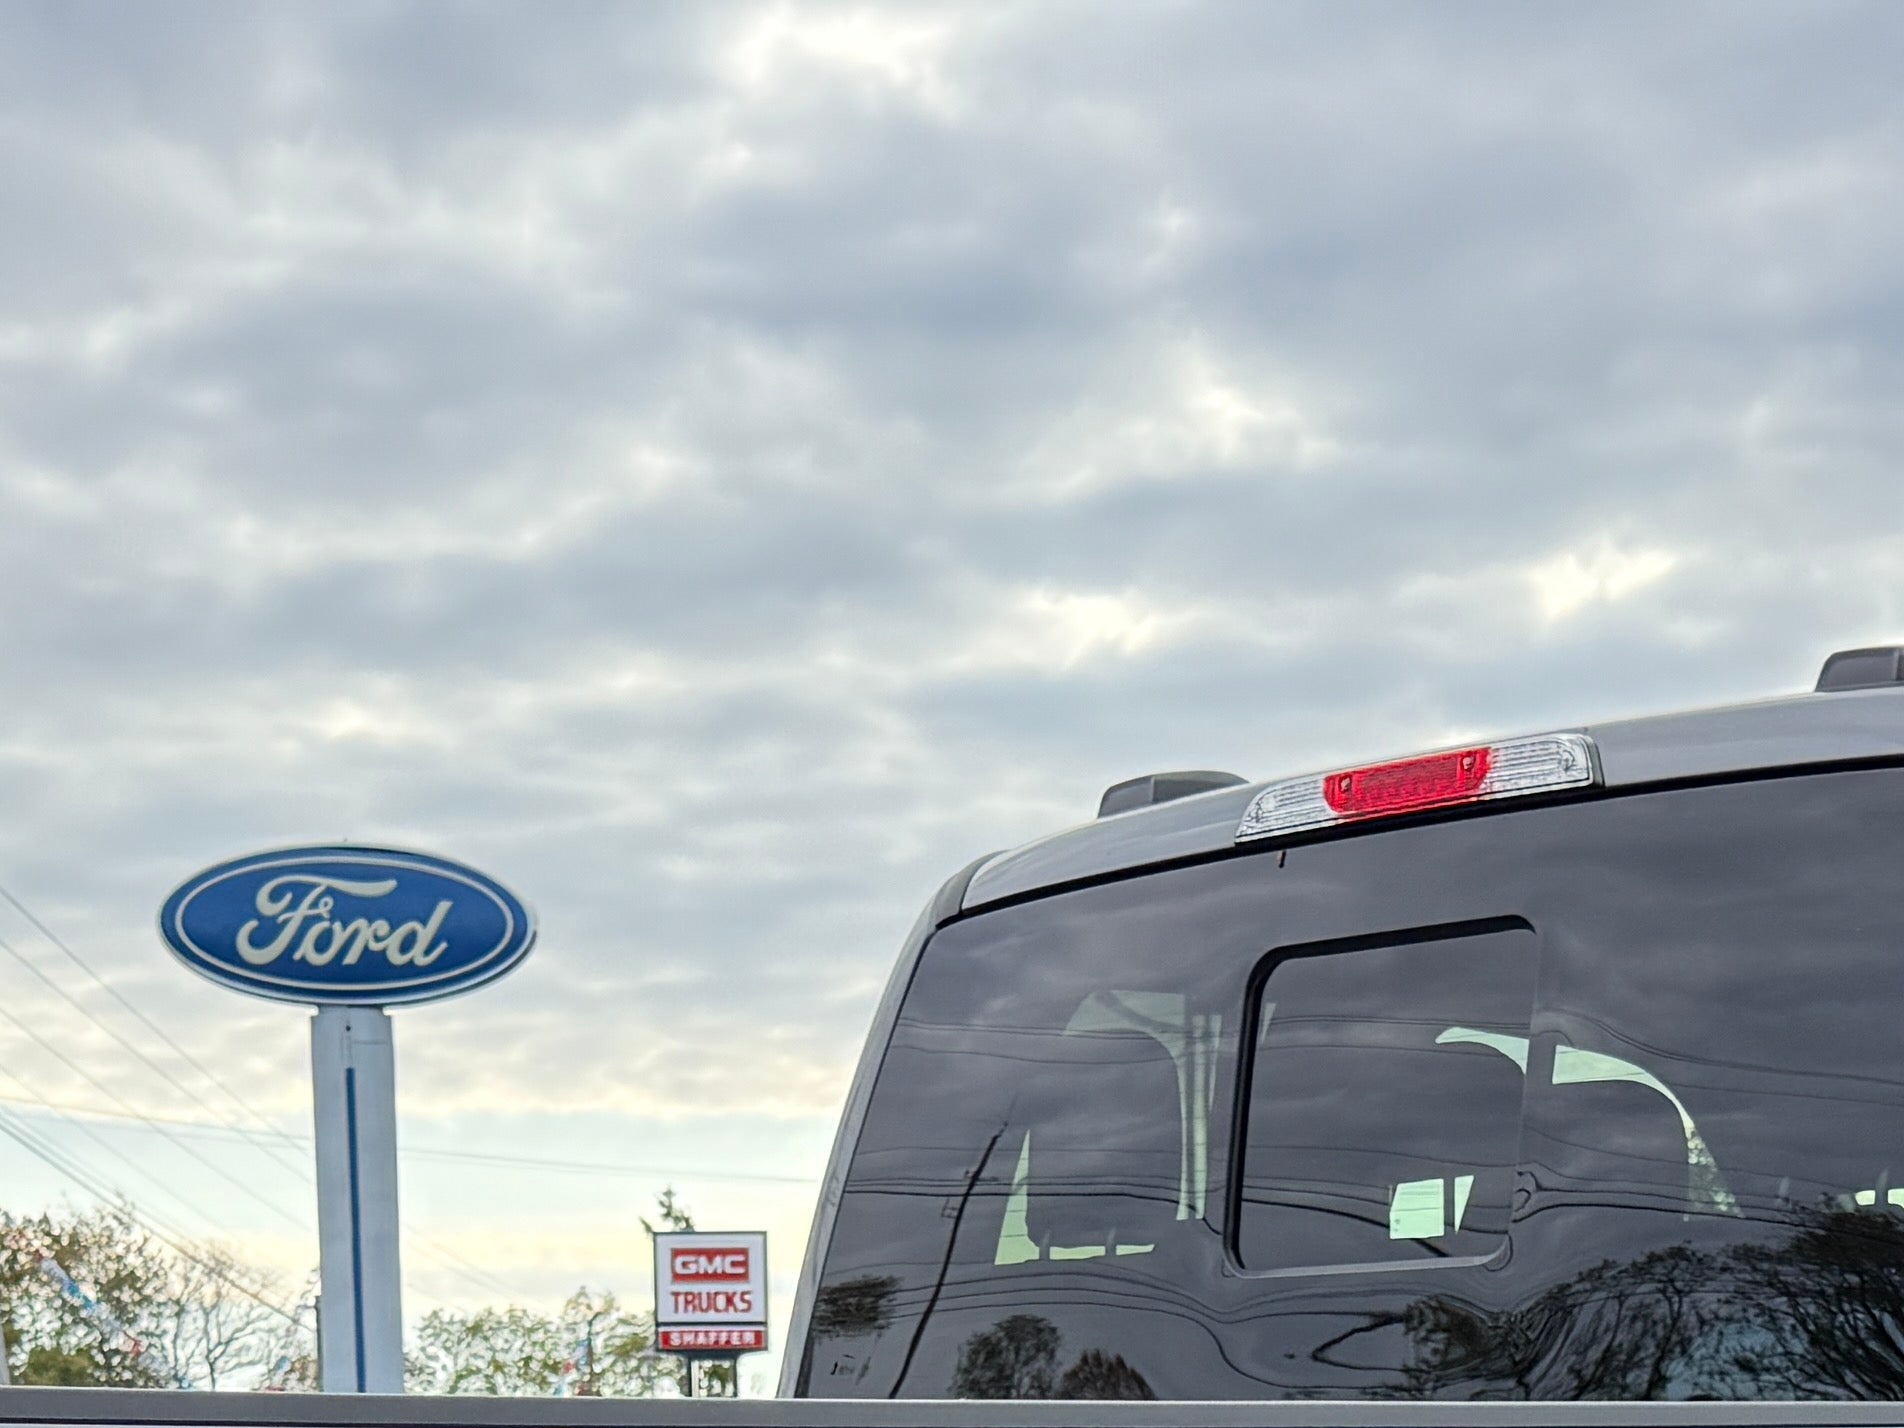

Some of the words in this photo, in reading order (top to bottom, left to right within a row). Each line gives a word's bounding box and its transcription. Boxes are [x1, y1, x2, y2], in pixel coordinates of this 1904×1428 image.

[236, 874, 453, 967] Ford
[675, 1254, 746, 1275] GMC
[671, 1290, 752, 1314] TRUCKS
